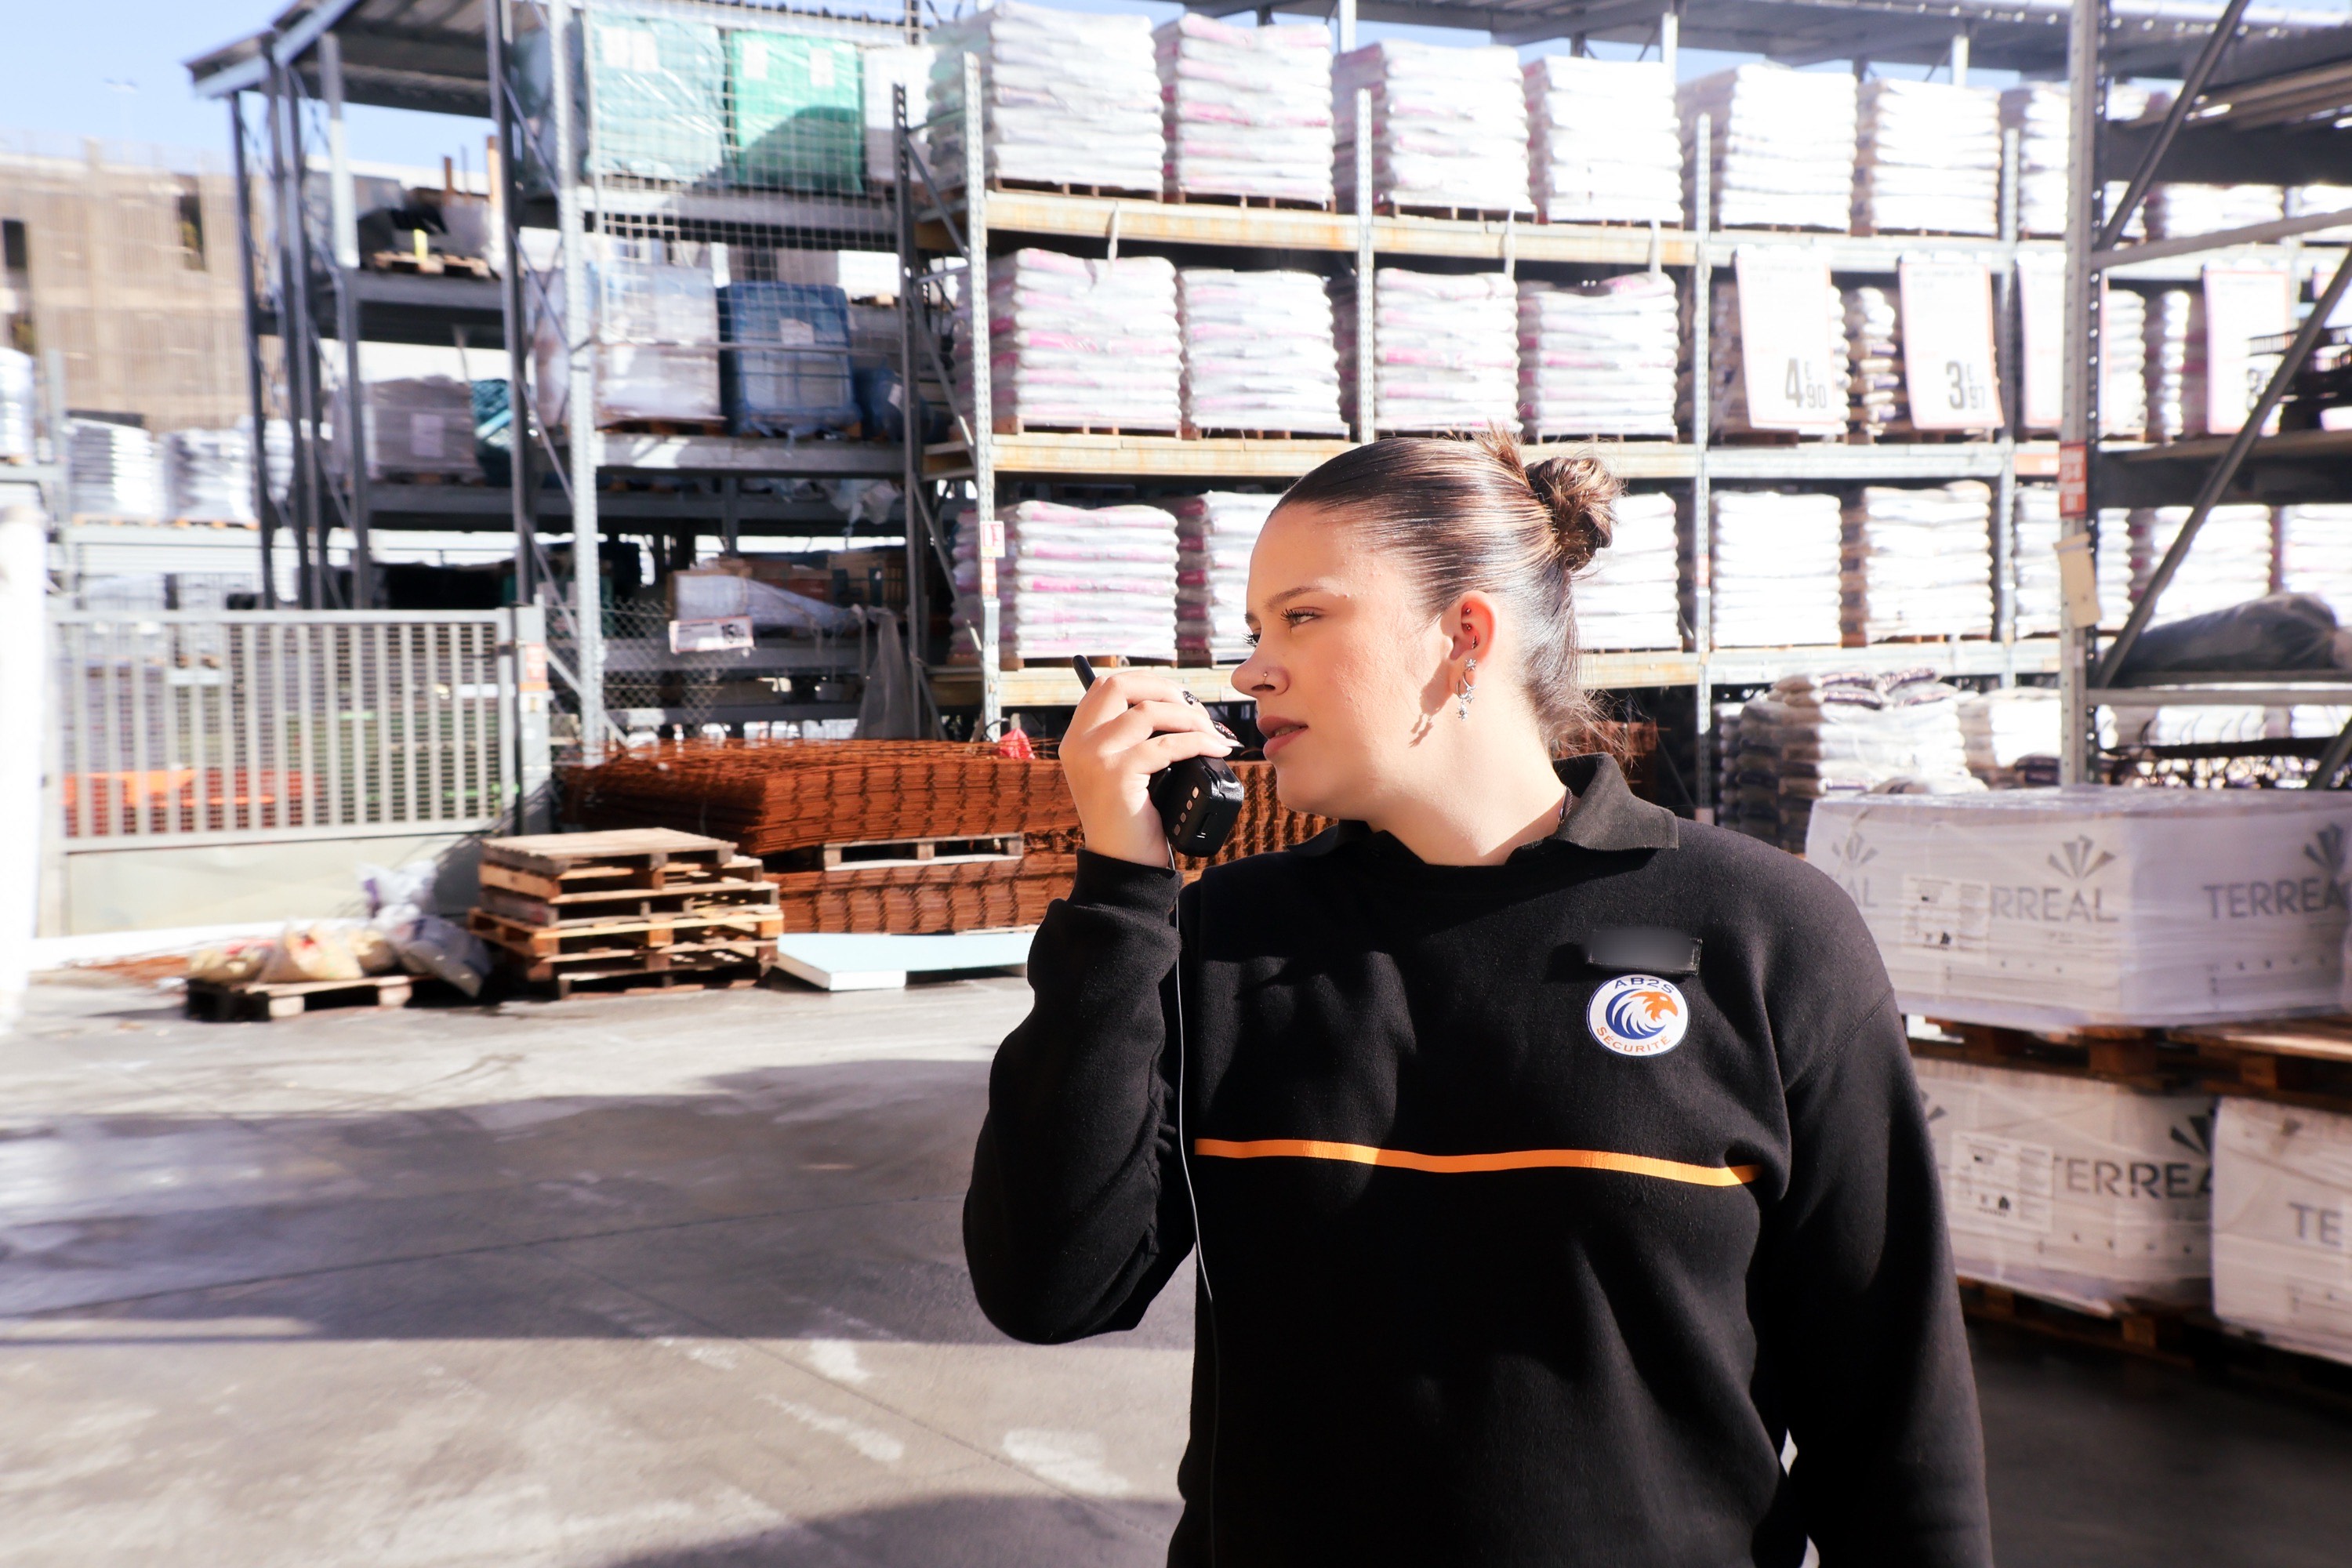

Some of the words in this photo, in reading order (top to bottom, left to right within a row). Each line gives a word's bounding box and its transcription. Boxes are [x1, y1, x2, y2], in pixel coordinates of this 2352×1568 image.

[1991, 885, 2119, 923] RREAL
[2202, 875, 2349, 919] TERREA
[1614, 977, 1675, 993] AB2S
[1596, 1026, 1671, 1052] SÉCURITÉ
